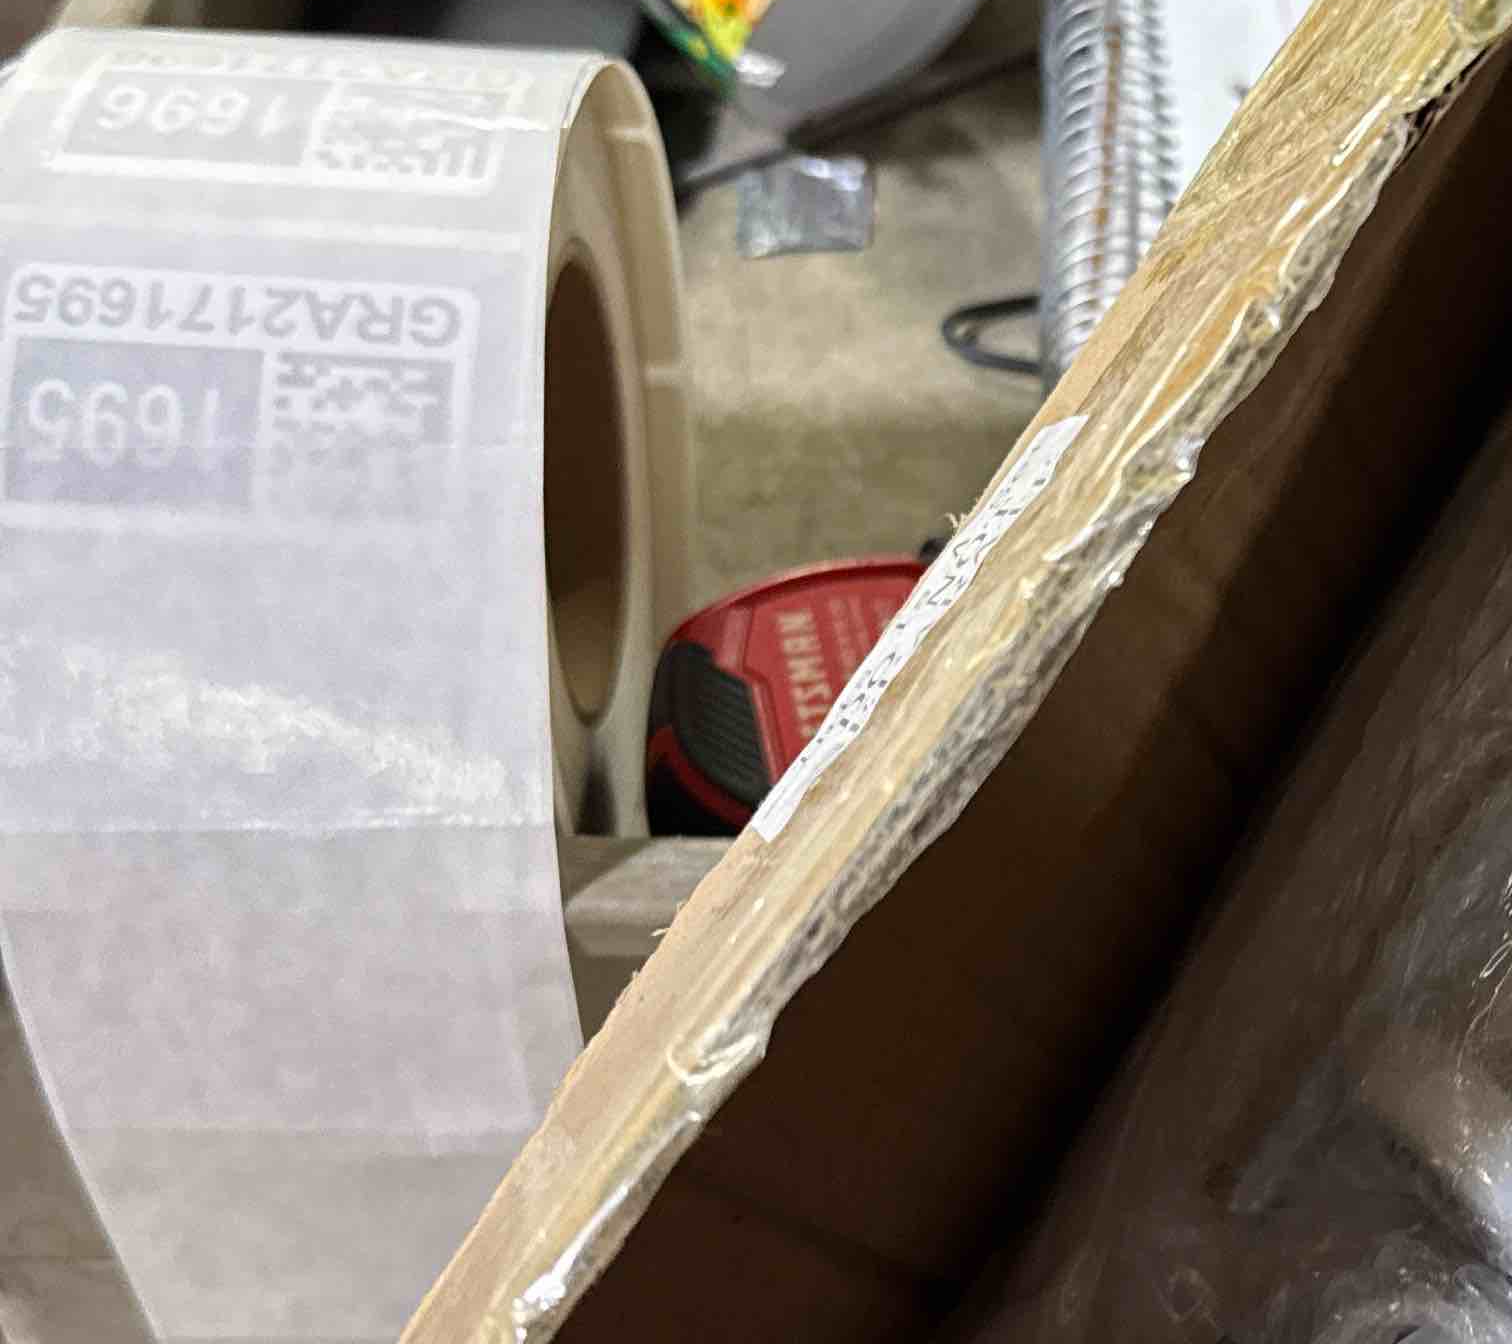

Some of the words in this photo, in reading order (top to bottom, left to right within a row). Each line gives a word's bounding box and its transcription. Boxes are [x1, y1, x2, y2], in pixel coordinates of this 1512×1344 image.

[98, 81, 288, 137] 1696
[14, 272, 464, 348] GRA2171695
[28, 377, 219, 469] 1695
